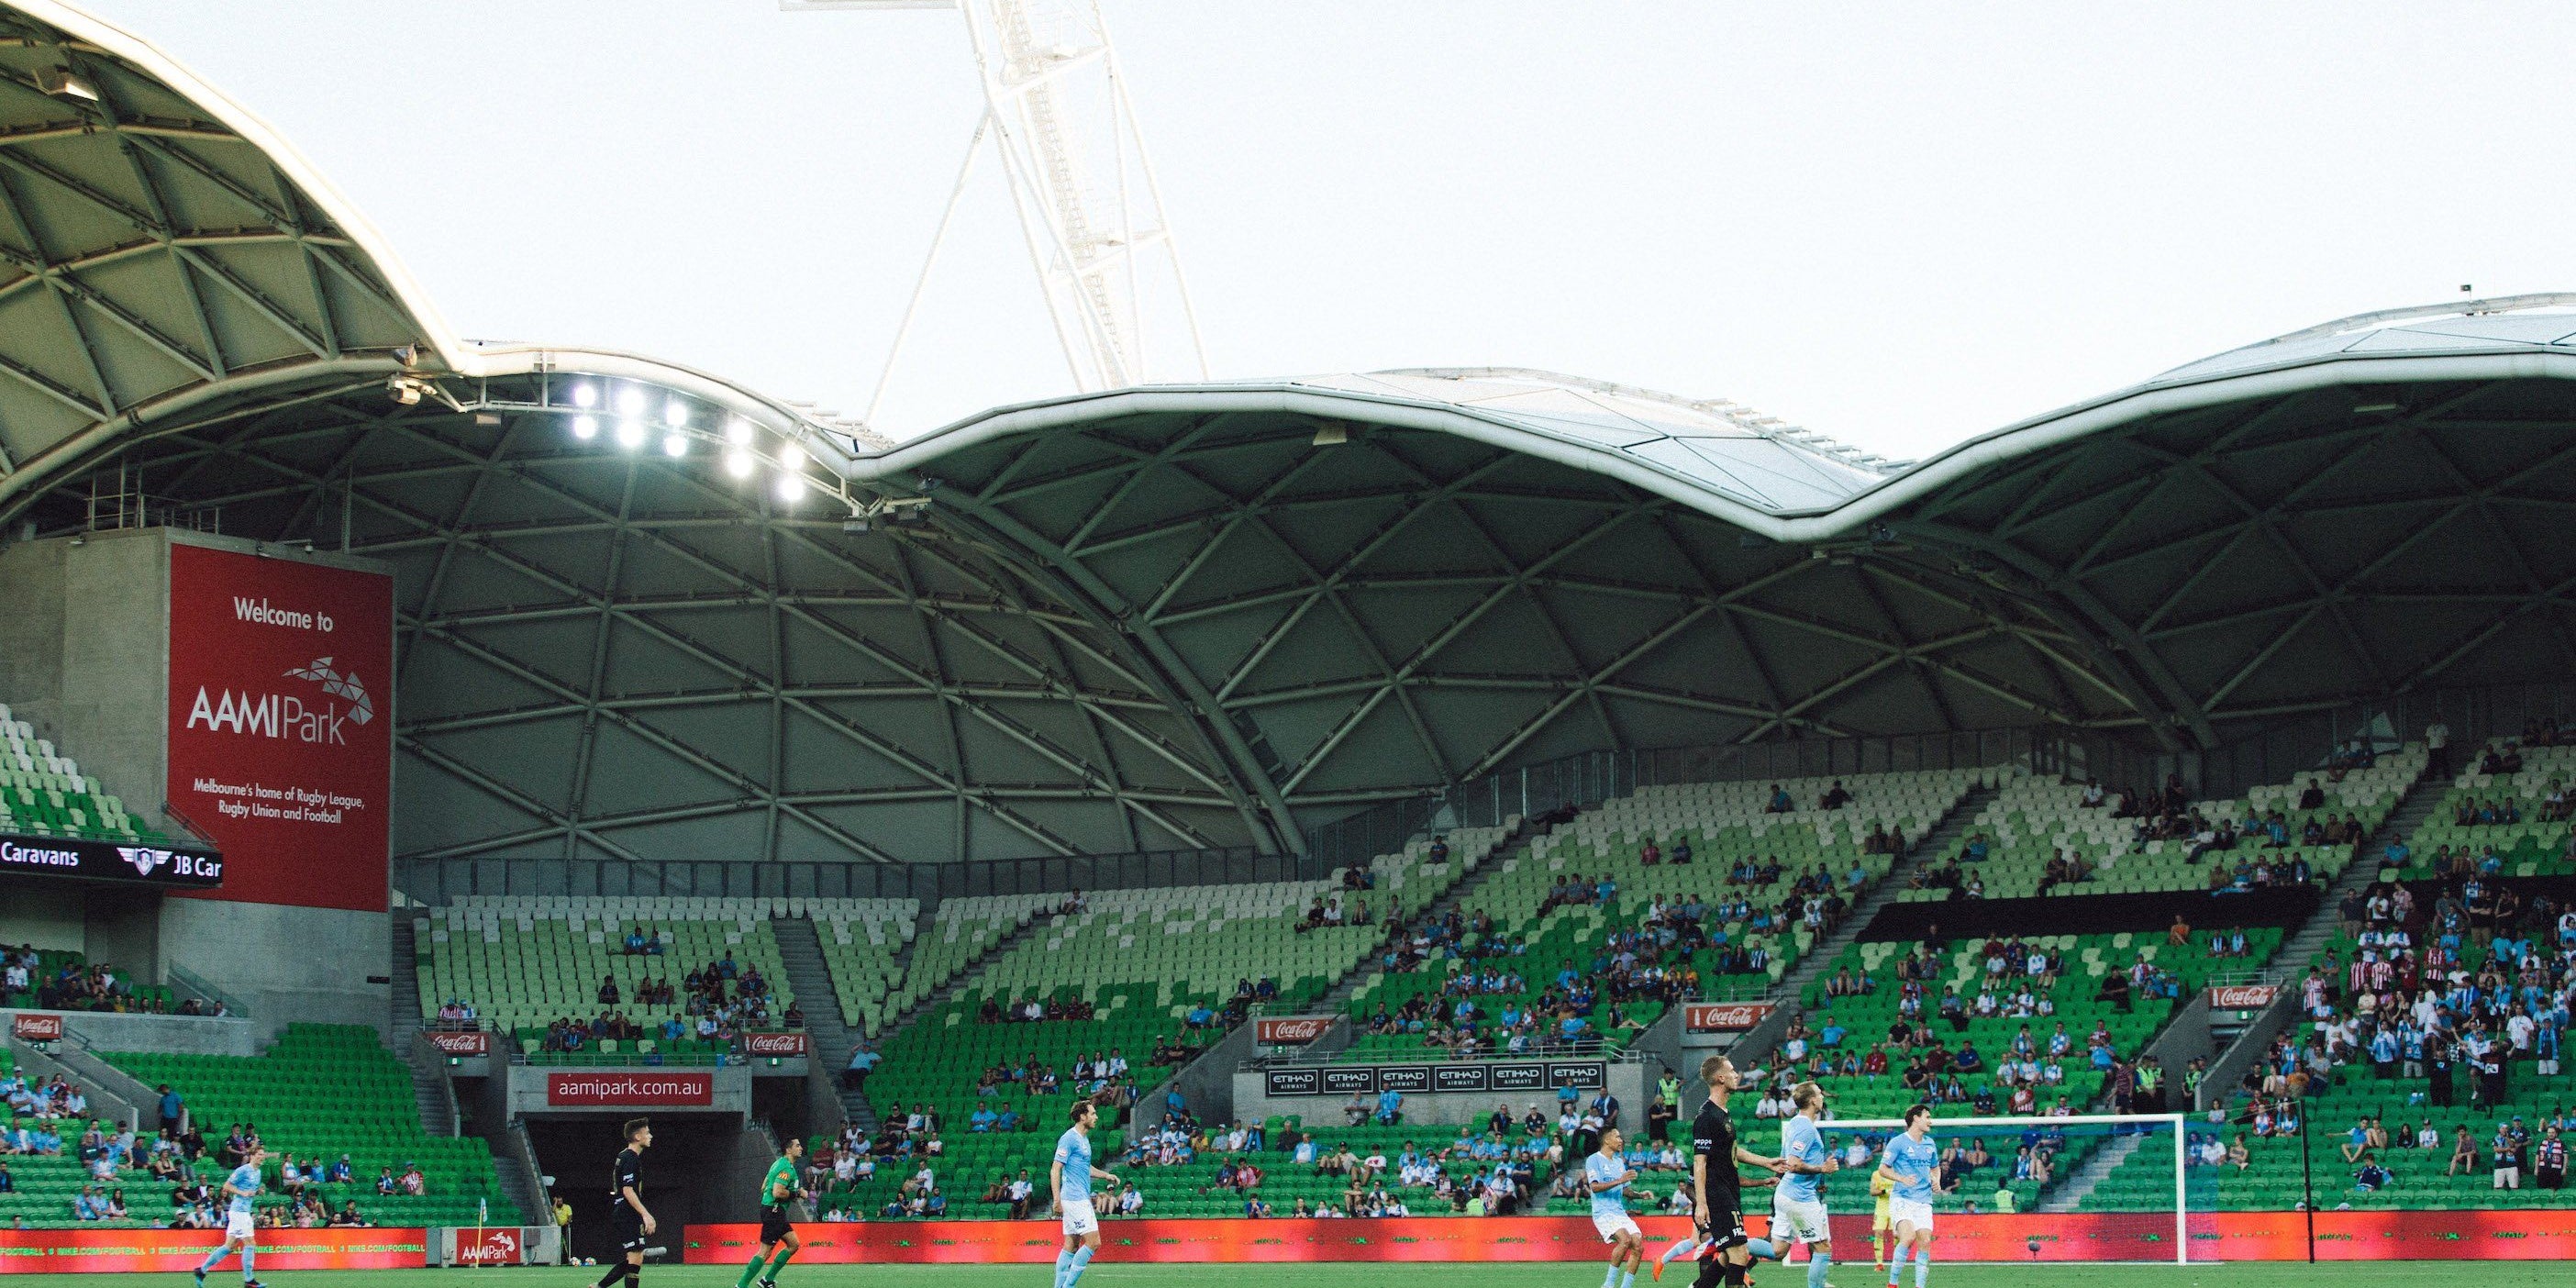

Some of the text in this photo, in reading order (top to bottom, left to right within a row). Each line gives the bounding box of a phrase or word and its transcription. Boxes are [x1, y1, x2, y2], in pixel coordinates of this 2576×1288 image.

[234, 596, 333, 632] Welcome to
[187, 685, 345, 745] AAMI Park
[194, 778, 365, 809] Melbourne's home of Rugby League,
[218, 800, 341, 824] Rugby Union and Football
[1, 842, 79, 867] Caravans
[173, 855, 222, 877] JB Car
[1276, 1021, 1318, 1038] Coca-Cola
[752, 1036, 797, 1050] Coca-Cola
[1327, 1073, 1369, 1082] ETIHAD
[1382, 1072, 1425, 1081] ETIHAD
[1439, 1071, 1482, 1080] ETIHAD
[1496, 1069, 1539, 1077] ETIHAD
[559, 1078, 702, 1100] aamipark.com.au
[255, 1245, 336, 1254] NIKE.COM/FOOTBALL
[489, 1245, 507, 1259] Park
